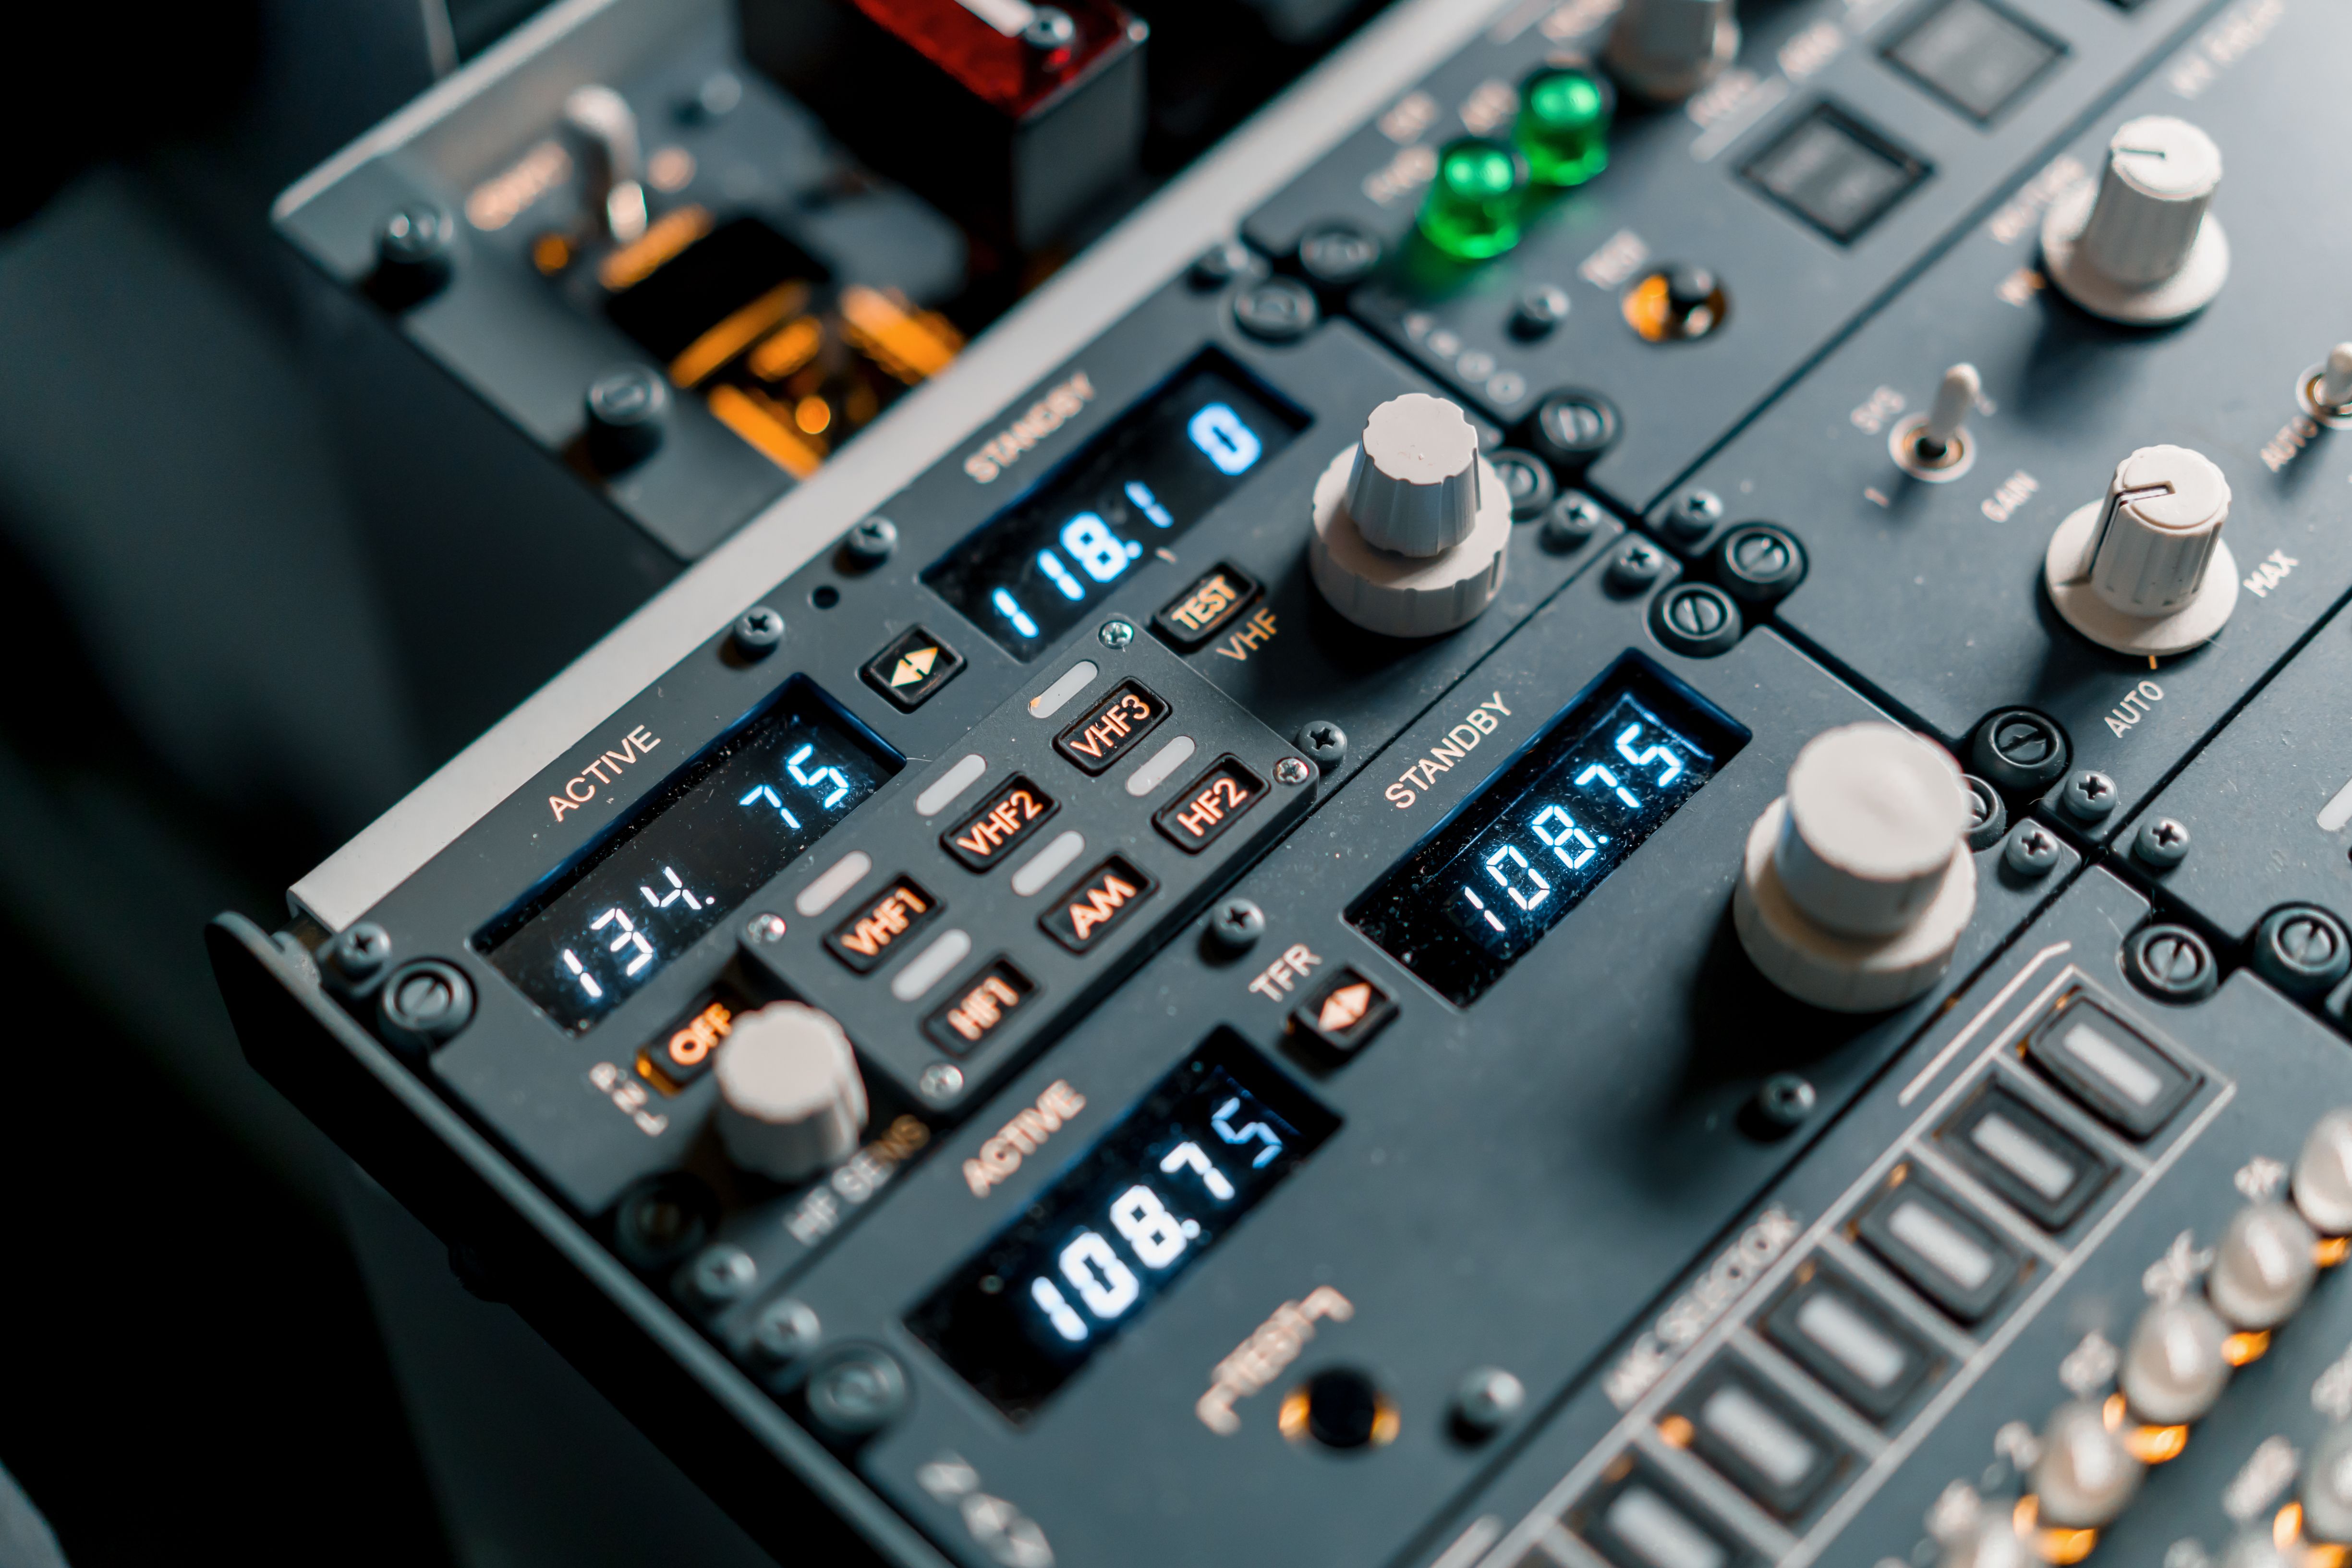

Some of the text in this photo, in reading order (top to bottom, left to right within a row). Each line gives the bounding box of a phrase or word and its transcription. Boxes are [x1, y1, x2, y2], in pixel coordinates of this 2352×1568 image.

[964, 370, 1095, 484] STANDBY
[2260, 415, 2317, 472] AUTO
[1980, 468, 2039, 523] GAIN
[1172, 575, 1236, 631] TEST
[2243, 549, 2299, 598] MAX
[1217, 608, 1278, 661] VHF
[1071, 694, 1151, 757] VHF3
[2104, 680, 2164, 739] AUTO
[548, 724, 661, 822] ACTIVE
[1384, 691, 1512, 809] STANDBY
[957, 790, 1043, 856] VHF2
[1176, 777, 1248, 837] HF2
[1464, 722, 1684, 932] 108.75
[841, 887, 928, 957] VHF1
[1069, 875, 1136, 940] AM
[1249, 943, 1322, 1002] TFR
[669, 1002, 731, 1065] OFF
[947, 975, 1019, 1041] HF1
[963, 1079, 1087, 1199] ACTIVE
[1031, 1097, 1283, 1342] 108.75
